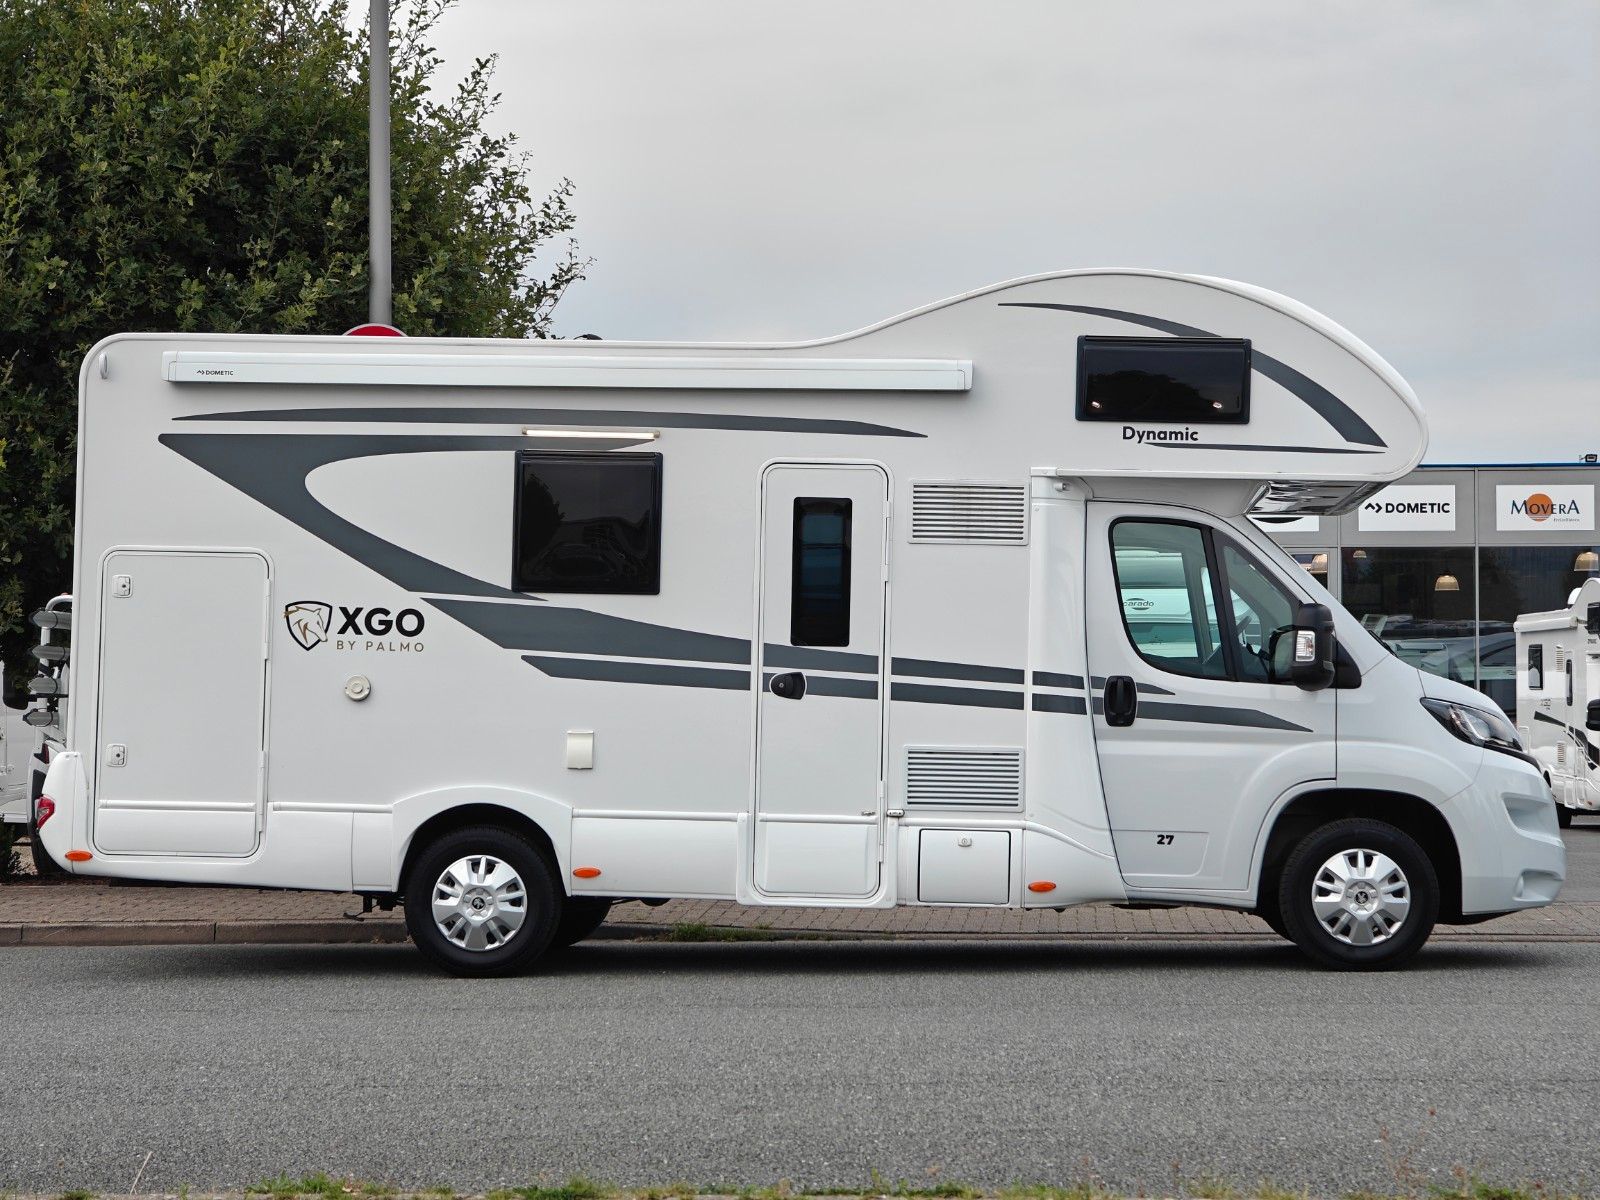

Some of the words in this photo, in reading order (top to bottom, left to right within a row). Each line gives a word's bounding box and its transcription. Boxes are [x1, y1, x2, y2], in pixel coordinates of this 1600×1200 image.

[1122, 426, 1199, 444] Dynamic
[1385, 502, 1451, 514] DOMETIC
[337, 606, 425, 637] XGO
[336, 640, 356, 651] BY
[365, 641, 424, 653] PALMO
[1156, 834, 1175, 846] 27
